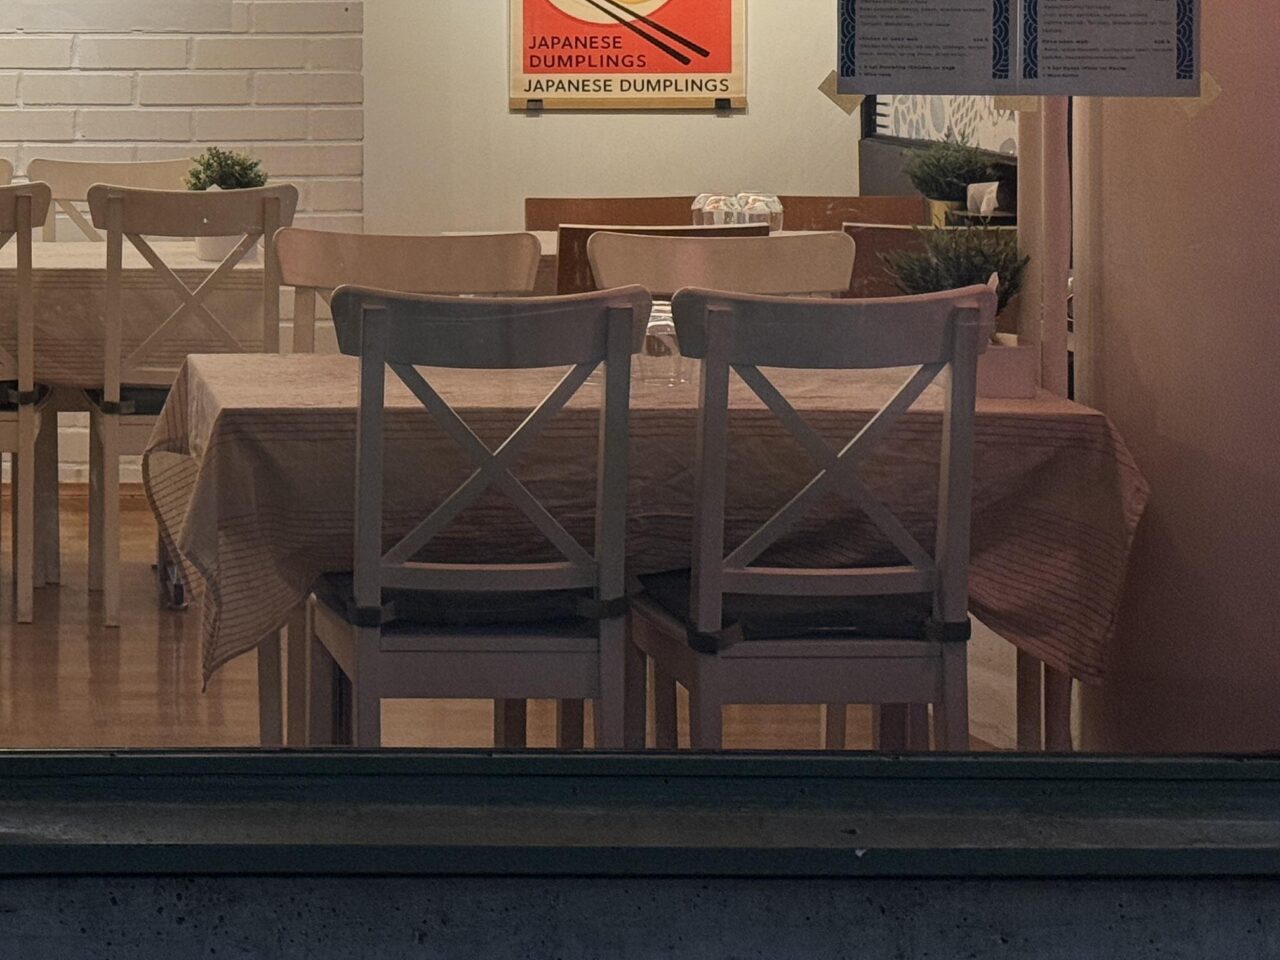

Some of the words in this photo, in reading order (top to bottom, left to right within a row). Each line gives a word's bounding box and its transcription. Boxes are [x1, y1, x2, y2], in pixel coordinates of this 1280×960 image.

[528, 35, 623, 50] JAPANESE
[529, 54, 647, 68] DUMPLINGS
[524, 78, 613, 93] JAPANESE
[619, 78, 729, 93] DUMPLINGS
